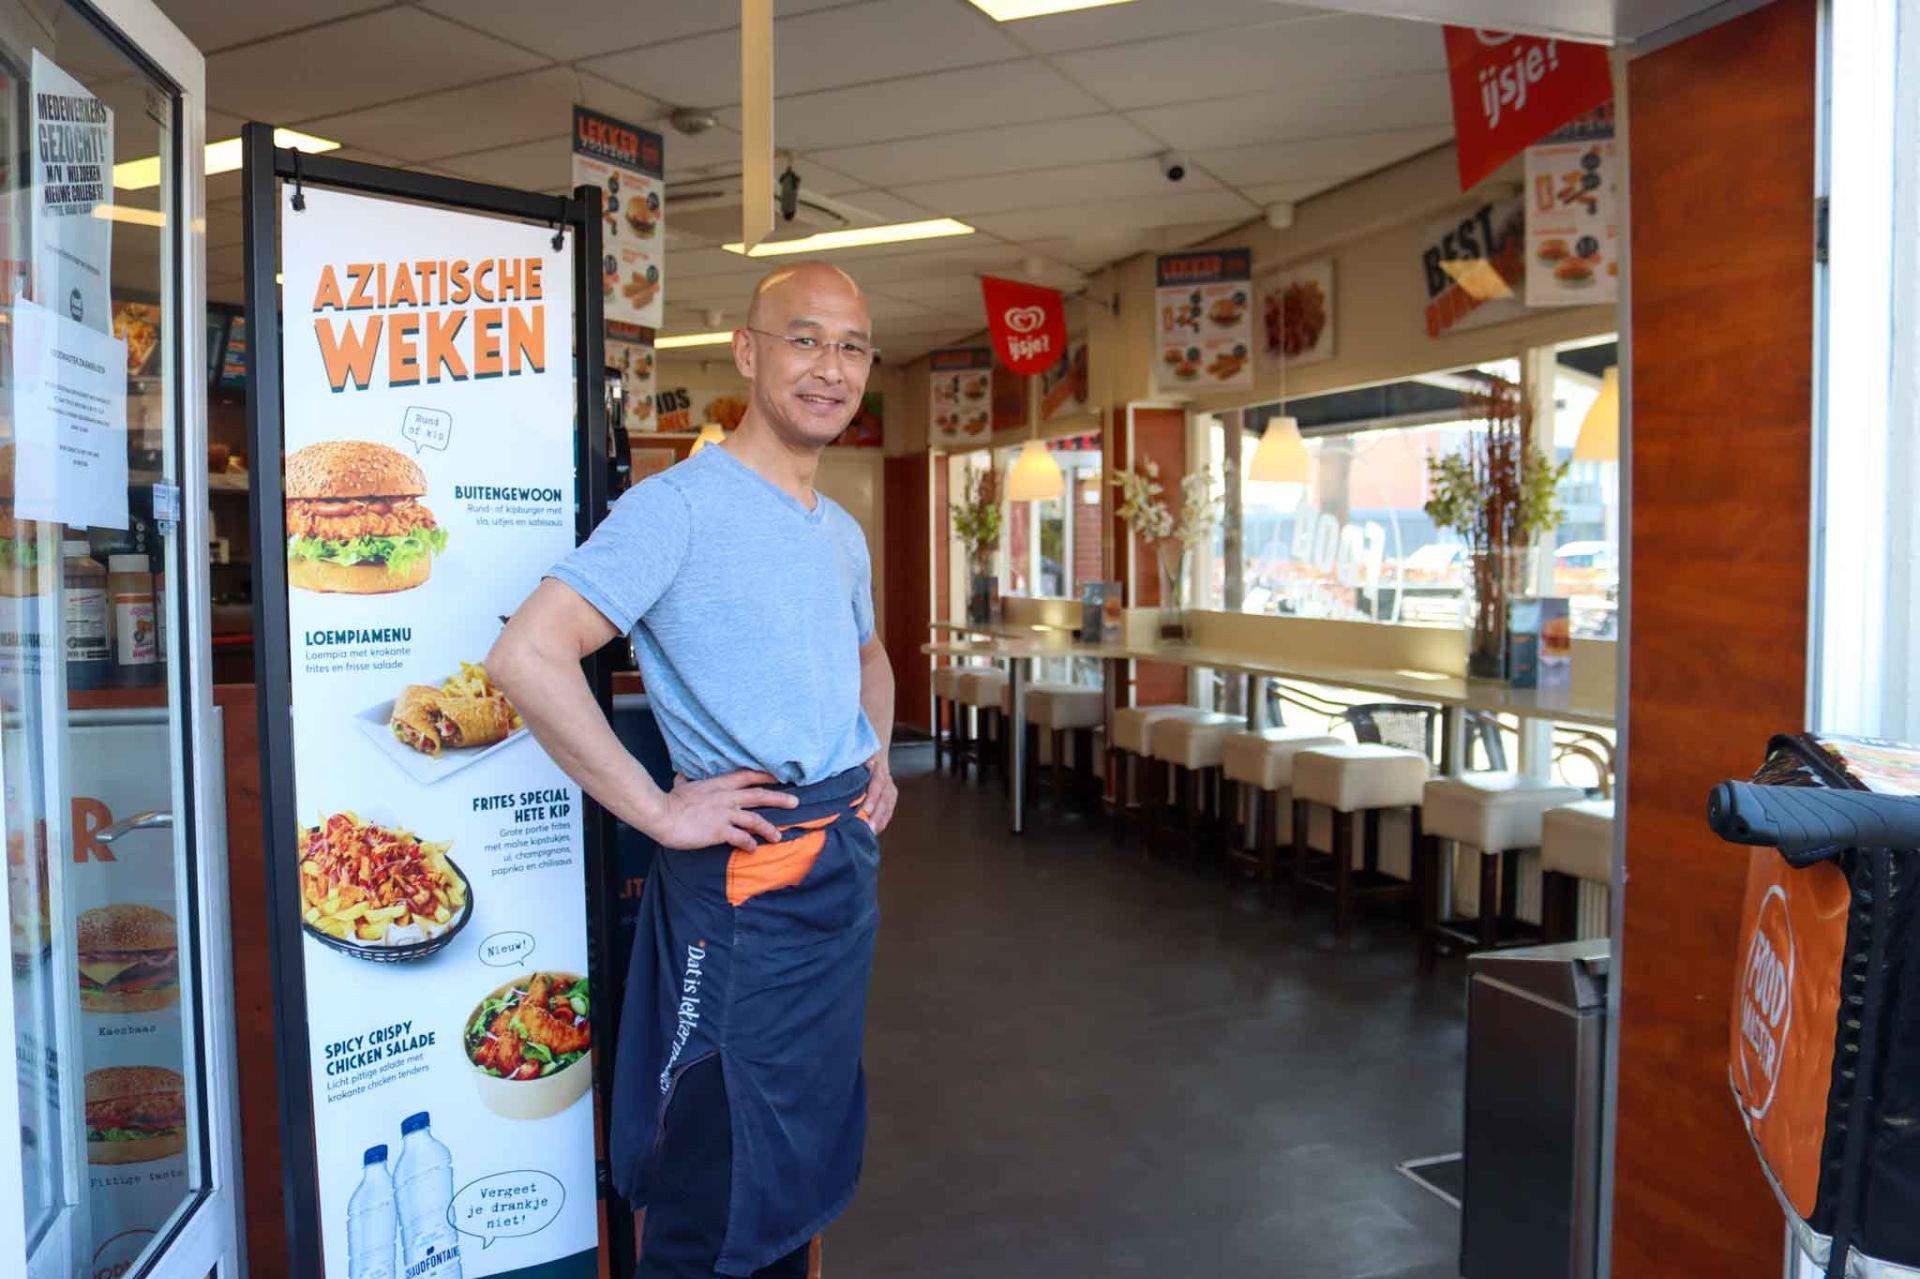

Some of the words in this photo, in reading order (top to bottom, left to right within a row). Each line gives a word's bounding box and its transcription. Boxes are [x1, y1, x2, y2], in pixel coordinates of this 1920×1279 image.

[37, 93, 107, 123] MEDEWERKERS
[312, 257, 543, 312] AZIATISCHE
[314, 305, 545, 394] WEKEN
[415, 413, 439, 427] Rund
[408, 425, 420, 436] of
[427, 428, 445, 441] kip
[455, 485, 562, 502] BUITENGEWOON
[495, 504, 504, 513] of
[506, 505, 544, 516] kipburger
[546, 506, 562, 515] met
[492, 517, 514, 529] uitjes
[305, 627, 412, 646] LOEMPIAMENU
[305, 651, 347, 661] Loempia
[349, 649, 368, 658] met
[370, 647, 411, 657] krokante
[306, 663, 330, 673] frites
[345, 661, 370, 671] frisse
[373, 660, 404, 670] salade
[472, 794, 516, 812] FRITES
[520, 788, 570, 806] SPECIAL
[514, 807, 545, 823] HETE
[549, 803, 571, 819] KIP
[499, 827, 523, 838] Grote
[525, 824, 550, 836] portie
[551, 821, 571, 831] frites
[484, 842, 502, 853] met
[504, 839, 529, 849] malse
[491, 864, 525, 878] paprika
[526, 863, 537, 871] en
[538, 858, 573, 869] chilisaus
[487, 938, 526, 958] Nieuw!
[686, 944, 706, 978] Dat
[683, 979, 701, 994] is
[1748, 928, 1786, 1028] FOOD
[676, 995, 700, 1046] lekker
[325, 1035, 364, 1060] SPICY
[369, 1020, 413, 1046] CRISPY
[326, 1046, 382, 1076] CHICKEN
[386, 1031, 436, 1057] SALADE
[327, 1077, 349, 1091] Licht
[351, 1066, 378, 1084] pittige
[379, 1057, 405, 1073] salade
[406, 1052, 424, 1063] met
[328, 1084, 366, 1104] krokante
[367, 1074, 397, 1091] chicken
[398, 1064, 430, 1080] tenders
[480, 1182, 537, 1199] Vergeet
[467, 1204, 483, 1219] je
[491, 1198, 549, 1213] drankje
[487, 1215, 526, 1229] niet!
